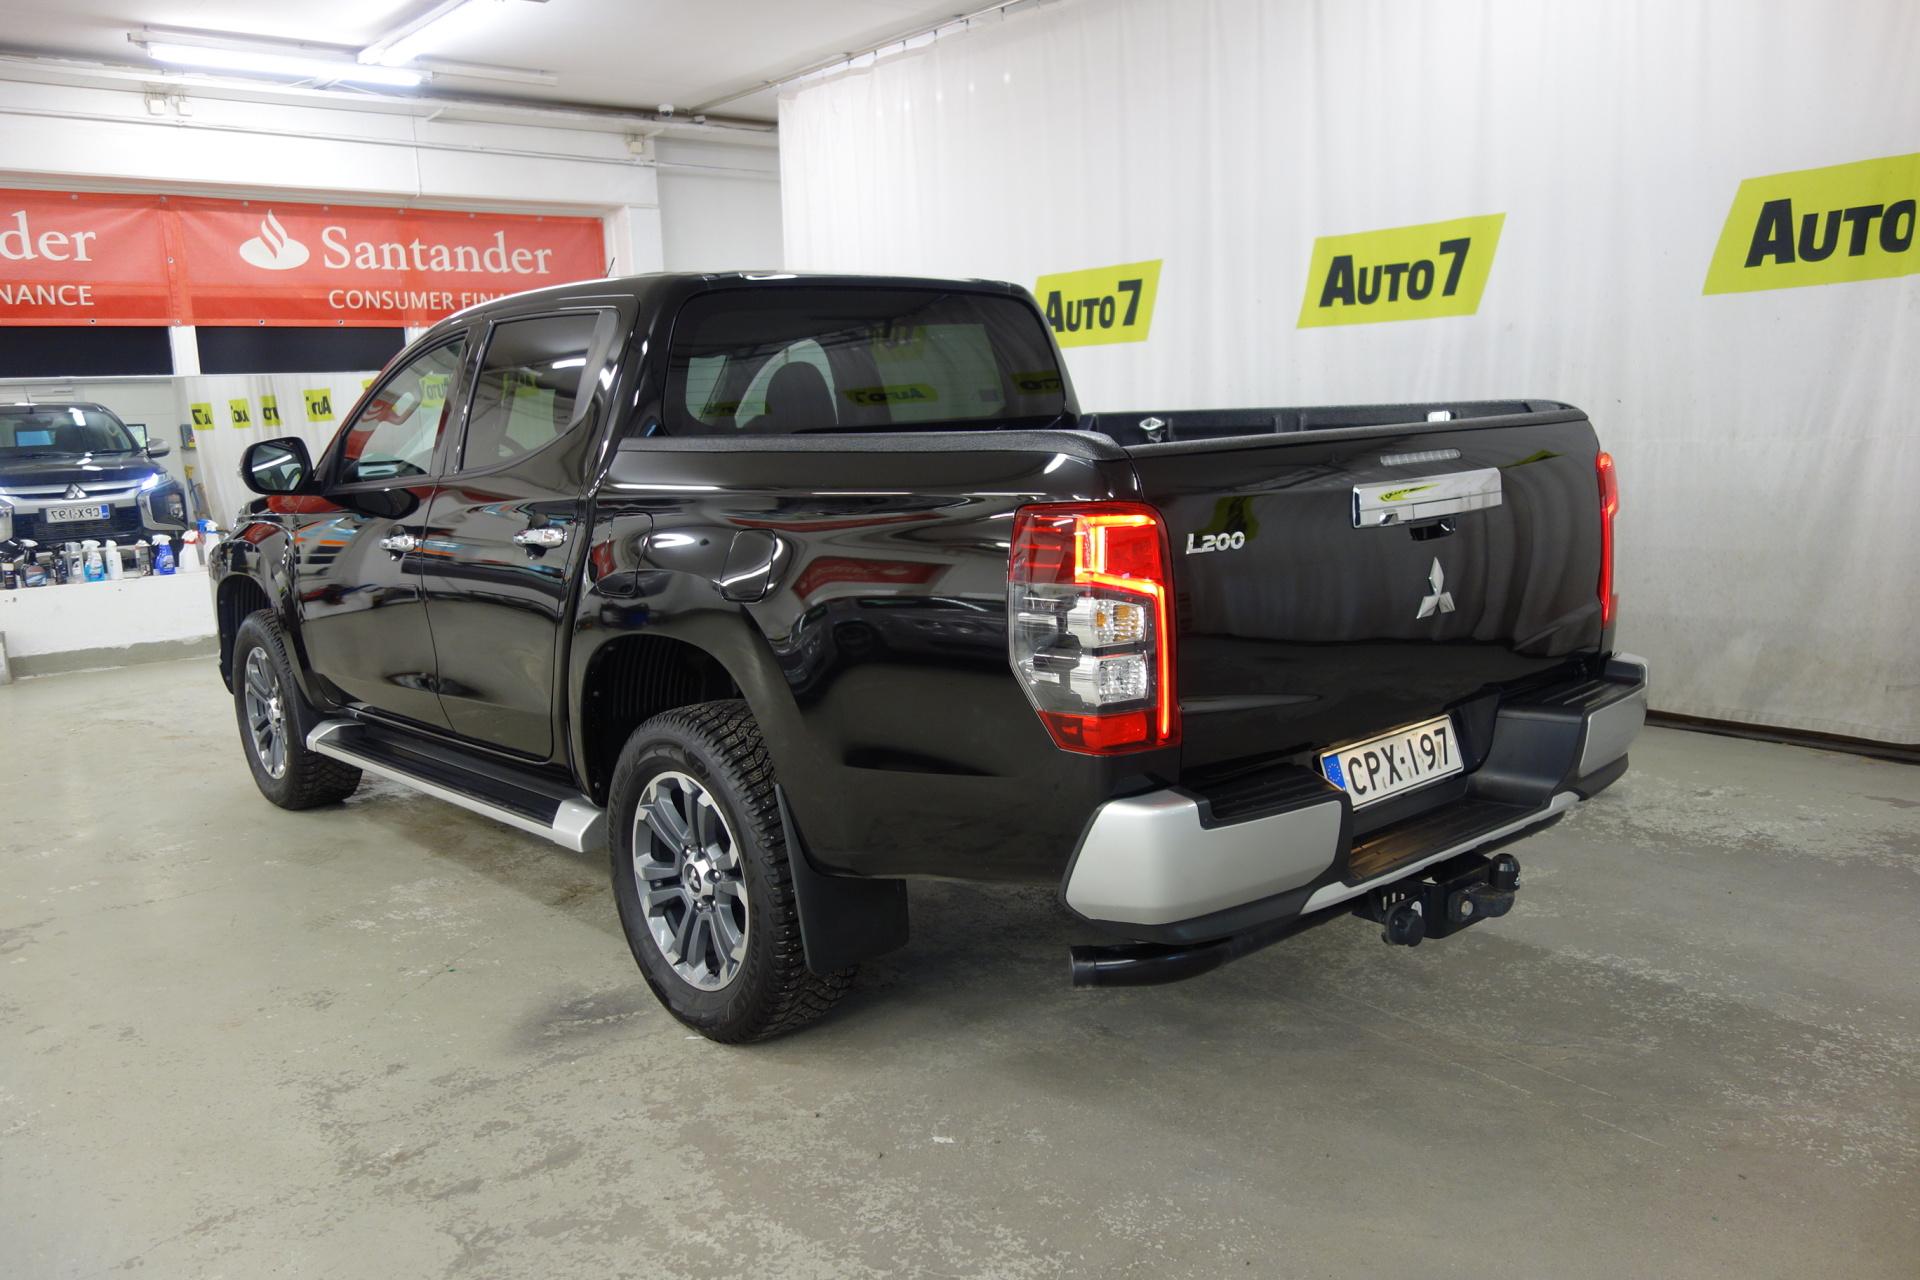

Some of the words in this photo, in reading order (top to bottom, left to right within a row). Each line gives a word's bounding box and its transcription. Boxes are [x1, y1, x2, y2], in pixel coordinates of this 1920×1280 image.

[321, 226, 553, 275] Santander
[328, 289, 455, 310] CONSUMER
[1185, 531, 1246, 555] L200
[1347, 726, 1449, 795] CPX-197
